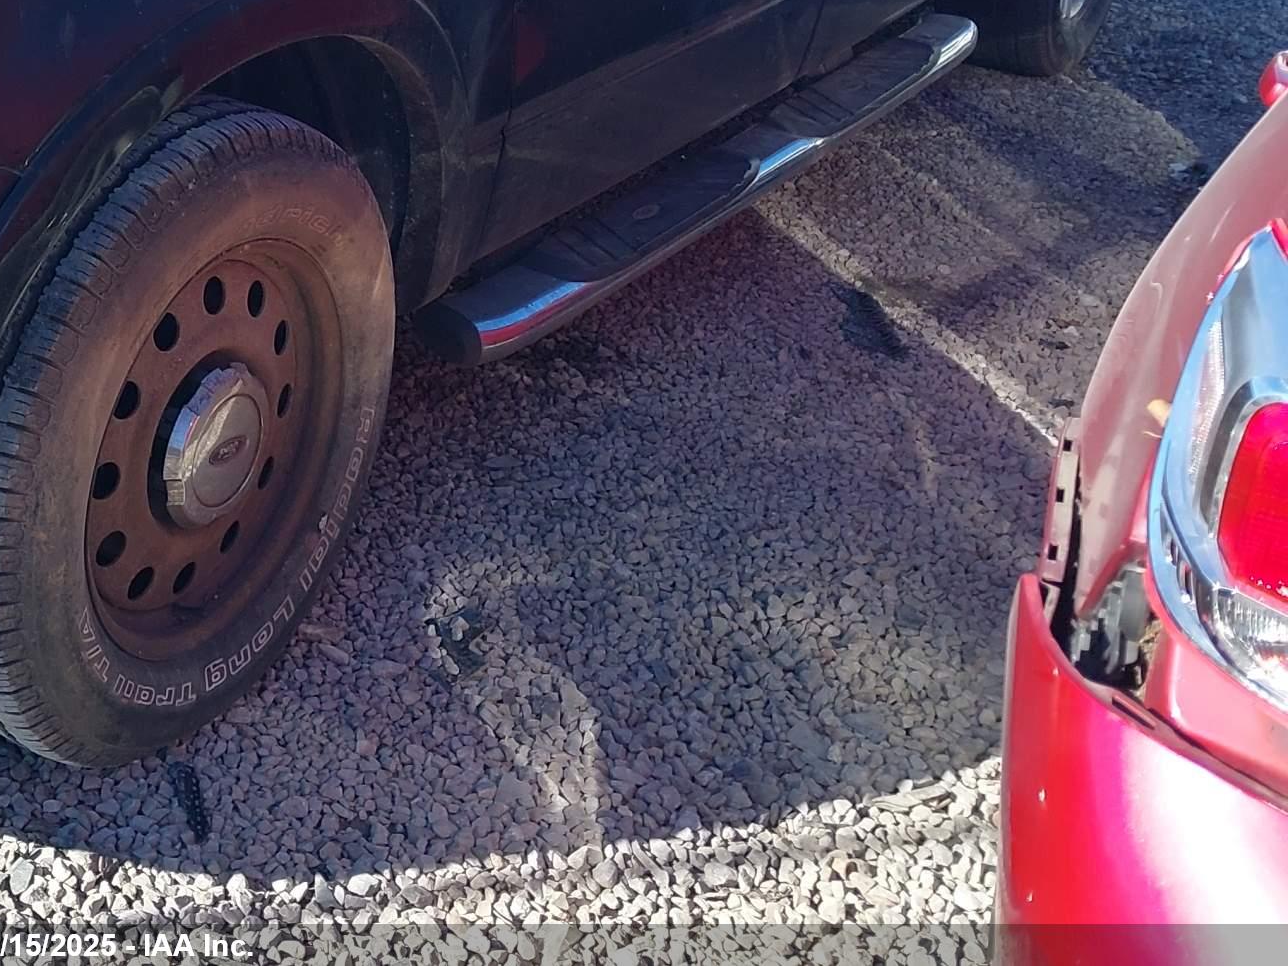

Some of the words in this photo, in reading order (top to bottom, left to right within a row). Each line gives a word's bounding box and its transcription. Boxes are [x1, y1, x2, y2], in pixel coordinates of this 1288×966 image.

[299, 408, 375, 591] Radial
[113, 674, 197, 706] Trail
[205, 595, 295, 691] Long
